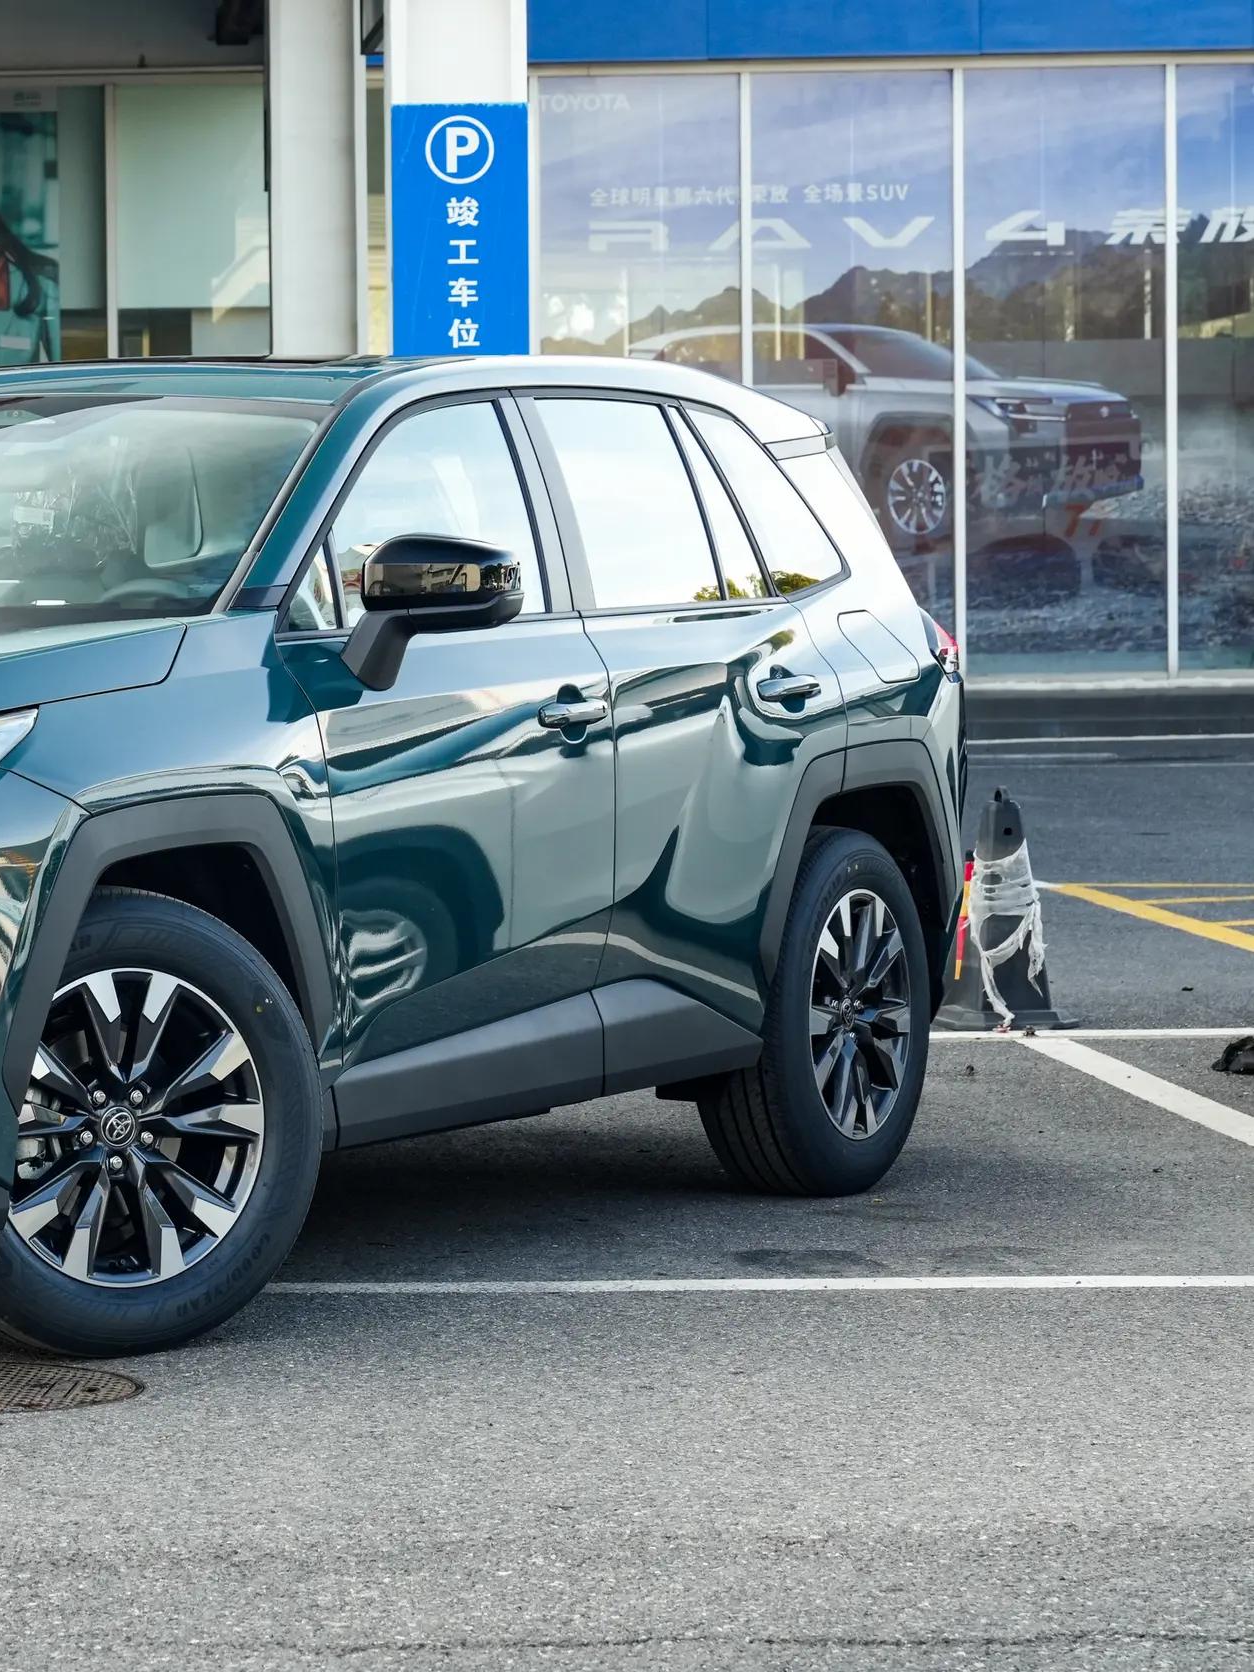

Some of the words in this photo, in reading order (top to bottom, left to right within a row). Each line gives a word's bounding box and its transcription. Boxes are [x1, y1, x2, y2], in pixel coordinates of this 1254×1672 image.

[539, 94, 632, 112] TOYOTA
[446, 126, 480, 174] P
[446, 196, 480, 348] 竣工车位
[176, 1232, 272, 1318] GOODYEAR
